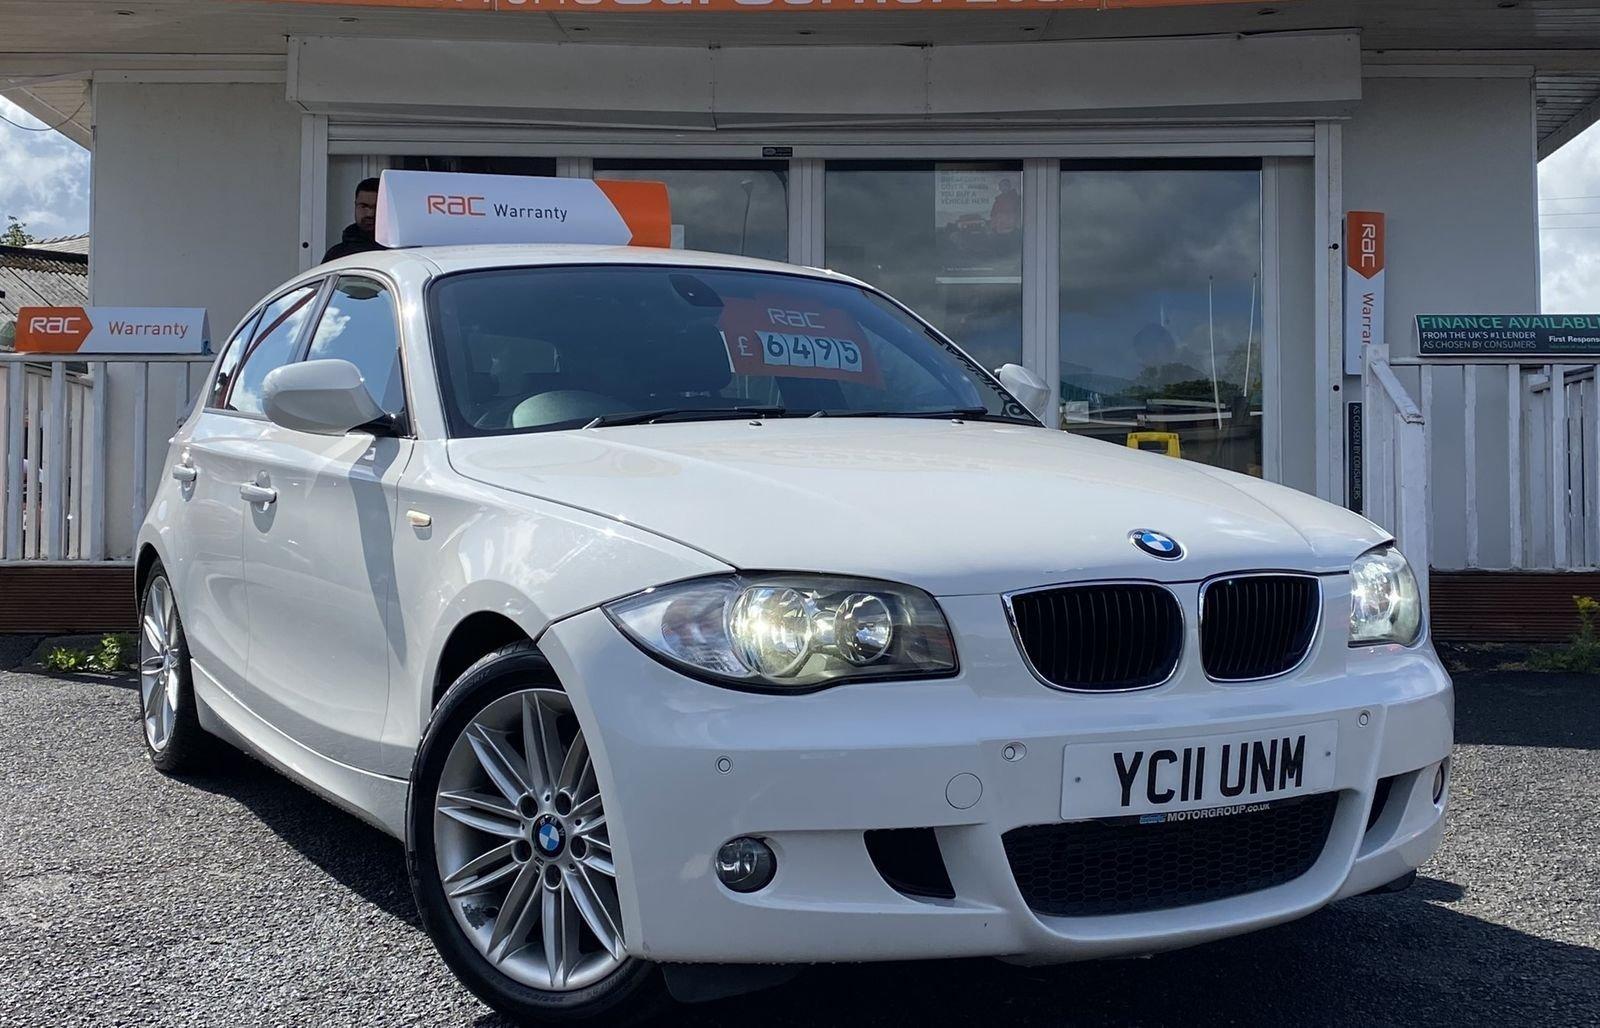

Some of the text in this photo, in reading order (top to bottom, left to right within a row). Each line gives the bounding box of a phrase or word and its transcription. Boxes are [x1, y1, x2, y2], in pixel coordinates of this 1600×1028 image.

[493, 203, 568, 222] Warranty
[1361, 292, 1375, 344] Warra
[1420, 316, 1504, 329] FINANCE
[108, 321, 189, 339] Warranty
[1422, 331, 1537, 339] FROM THE UK'S #1 LENDER
[1548, 335, 1566, 343] First
[766, 335, 858, 364] 6495
[1422, 340, 1537, 349] AS CHOSEN BY CONSUMERS
[1353, 415, 1361, 444] CHOSEN
[1353, 456, 1361, 500] CONSUMERS
[1113, 735, 1306, 806] YC11 UNM
